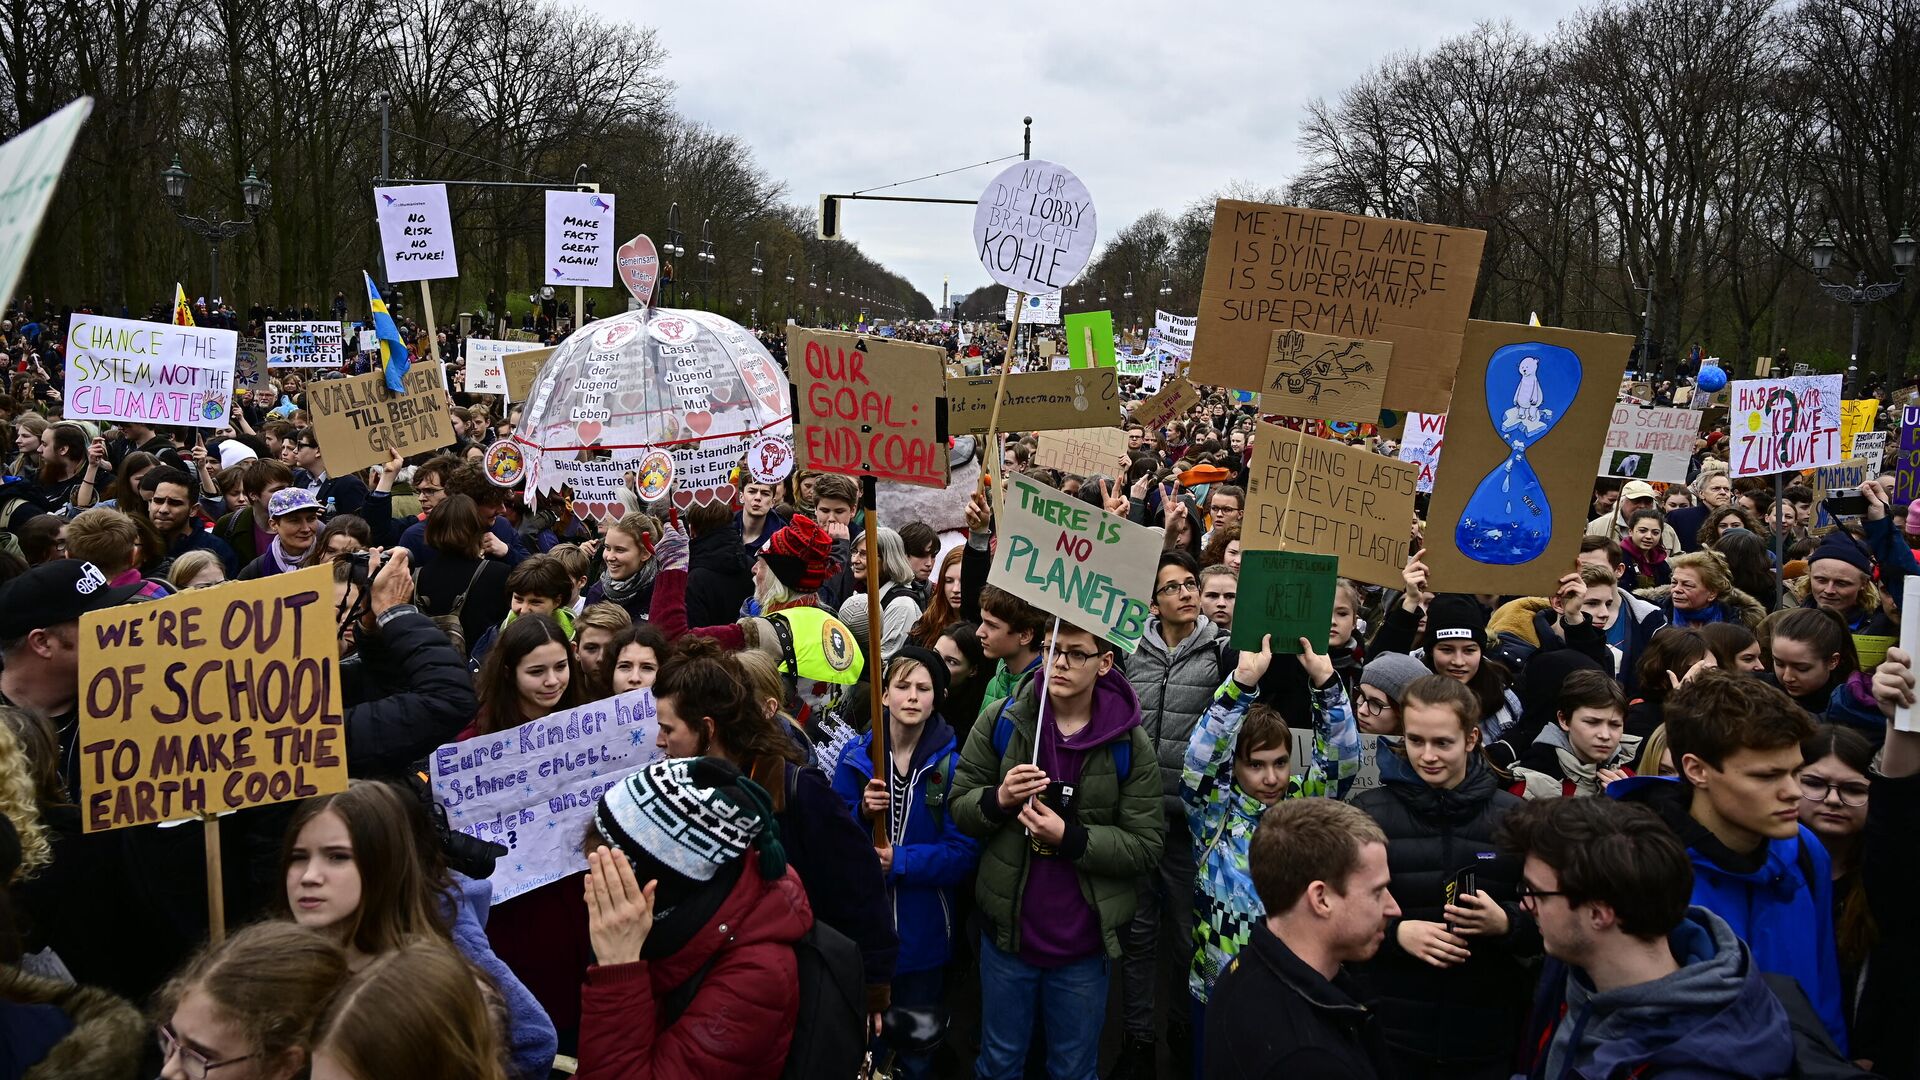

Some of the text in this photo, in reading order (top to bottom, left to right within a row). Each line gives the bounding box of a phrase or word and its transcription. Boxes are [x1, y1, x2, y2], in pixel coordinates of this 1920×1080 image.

[1020, 168, 1066, 198] NUR
[993, 184, 1089, 228] DIE LOBBY
[563, 216, 599, 228] MAKE
[989, 207, 1078, 250] BRAUCHT
[564, 230, 598, 240] FACTS
[1341, 220, 1450, 260] PLANET
[396, 250, 444, 261] FUTURE!
[562, 243, 599, 254] GREAT
[981, 228, 1067, 288] KOHLE
[1233, 241, 1260, 263] IS
[559, 255, 598, 266] AGAIN!
[620, 256, 656, 267] Gemeinsam
[1229, 268, 1255, 290] IS
[269, 324, 340, 334] ERHEBE DEINE
[1158, 312, 1197, 326] Das Proble
[1219, 300, 1383, 336] SUPERMAN:
[72, 322, 216, 359] CHANGE THE
[270, 335, 314, 345] STIMME,
[315, 335, 341, 344] NICHT
[270, 346, 291, 354] DEN
[295, 345, 341, 353] MEERES-
[661, 344, 696, 355] Lasst
[1160, 333, 1193, 347] Kapitalism
[284, 354, 341, 363] SPIEGEL!
[588, 353, 620, 362] Lasst
[677, 358, 697, 367] der
[805, 341, 870, 386] OUR
[74, 354, 230, 390] SYSTEM, NOT THE
[591, 366, 610, 375] der
[666, 370, 713, 383] Jugend
[311, 368, 441, 416] VÄLKOMEN
[574, 380, 618, 391] Jugend
[677, 385, 709, 396] Ihren
[72, 386, 204, 422] CLIMATE
[386, 394, 441, 423] BERLIN,
[585, 394, 601, 404] Ihr
[684, 400, 708, 409] Mut
[952, 397, 966, 412] ist
[970, 398, 986, 410] ein
[1740, 386, 1786, 411] HABEN
[345, 407, 384, 430] TILL
[573, 409, 608, 419] Leben
[1419, 413, 1446, 435] WI
[1610, 409, 1699, 433] ND SCHLAU,
[1772, 407, 1822, 436] KEINE
[368, 414, 439, 453] GRETA!
[1606, 430, 1697, 452] ER WARUM
[672, 441, 750, 462] eibt standhaft
[806, 425, 945, 476] END COAL
[1739, 428, 1838, 474] ZUKUNFT
[555, 459, 640, 472] Bleibt standhaft
[674, 460, 736, 475] es ist Eure
[1269, 440, 1346, 477] NOTHING
[1357, 460, 1415, 496] LASTS
[1866, 462, 1876, 472] ET!
[568, 477, 624, 486] es ist Eure
[680, 474, 727, 489] Zukunft
[575, 490, 617, 501] Zukunft
[1016, 481, 1091, 531] THERE
[1056, 531, 1093, 562] NO
[1260, 504, 1408, 570] EXCEPT PLASTIC
[1005, 535, 1151, 640] PLANET B
[96, 590, 319, 659] WE'RE OUT
[87, 657, 342, 725] OF SCHOOL
[436, 692, 656, 777] Eure Kinder hab
[84, 727, 340, 784] TO MAKE THE
[830, 741, 840, 752] Juge
[90, 766, 318, 831] EARTH COOL
[443, 769, 528, 808] Schnee
[458, 780, 616, 840] erden unser
